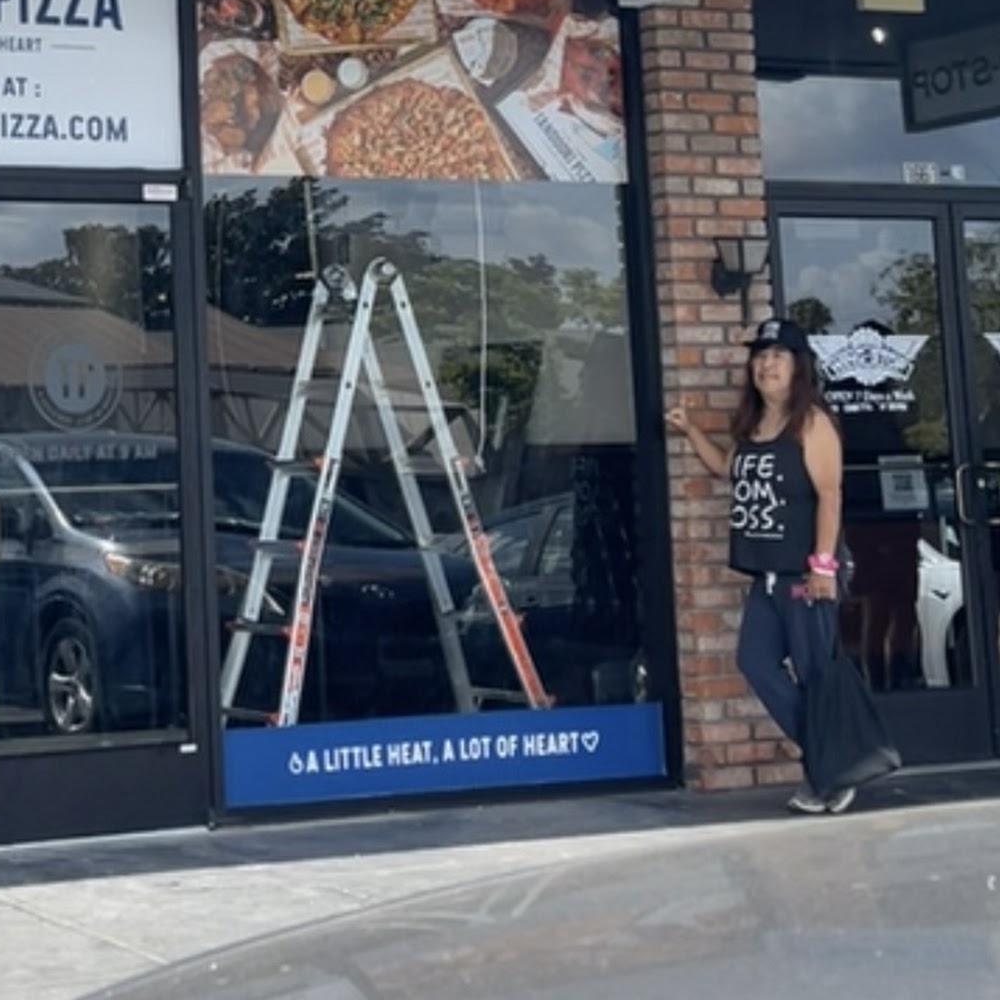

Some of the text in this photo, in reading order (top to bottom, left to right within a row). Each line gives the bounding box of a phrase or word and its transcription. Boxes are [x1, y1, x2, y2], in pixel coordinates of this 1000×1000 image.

[0, 36, 43, 53] HEART
[2, 76, 28, 97] AT
[733, 454, 785, 482] IFE.
[734, 479, 787, 507] OM.
[730, 504, 785, 530] OSS.
[306, 750, 319, 774] A
[323, 744, 384, 772] LITTLE
[442, 738, 456, 763] A
[459, 736, 492, 761] LOT
[495, 734, 518, 758] OF
[521, 731, 581, 757] HEART
